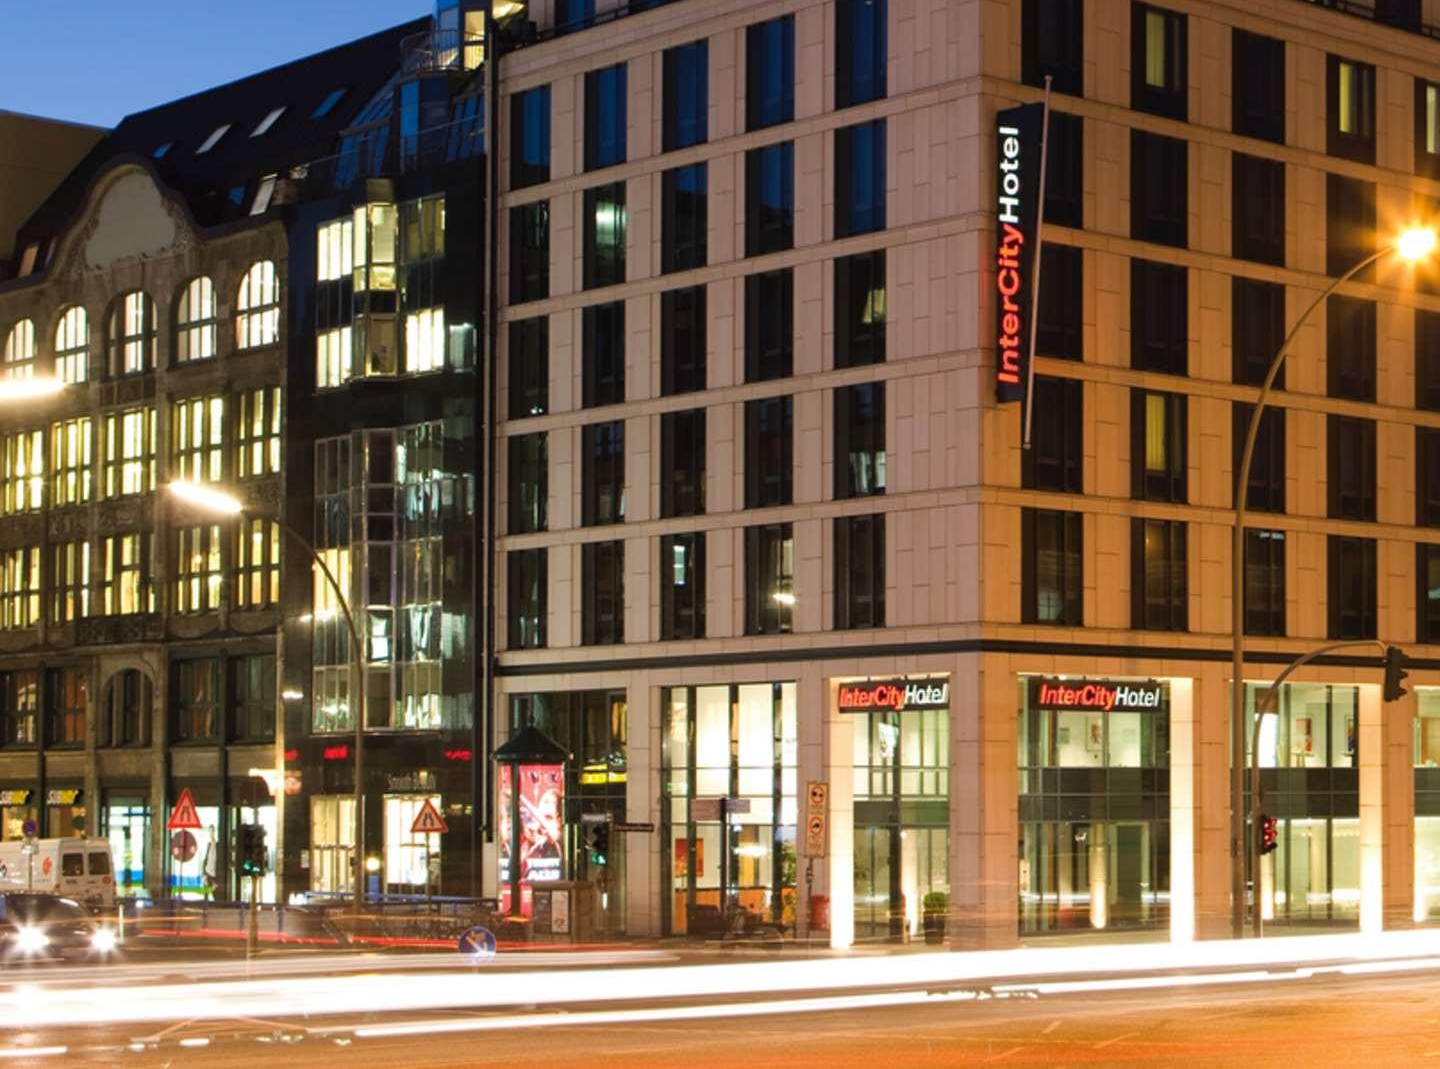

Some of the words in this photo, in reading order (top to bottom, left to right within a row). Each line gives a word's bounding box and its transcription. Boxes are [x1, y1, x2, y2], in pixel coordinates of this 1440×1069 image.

[998, 126, 1024, 383] InterCityHotel
[839, 682, 948, 711] InterCityHotel
[1040, 683, 1160, 711] InterCityHotel
